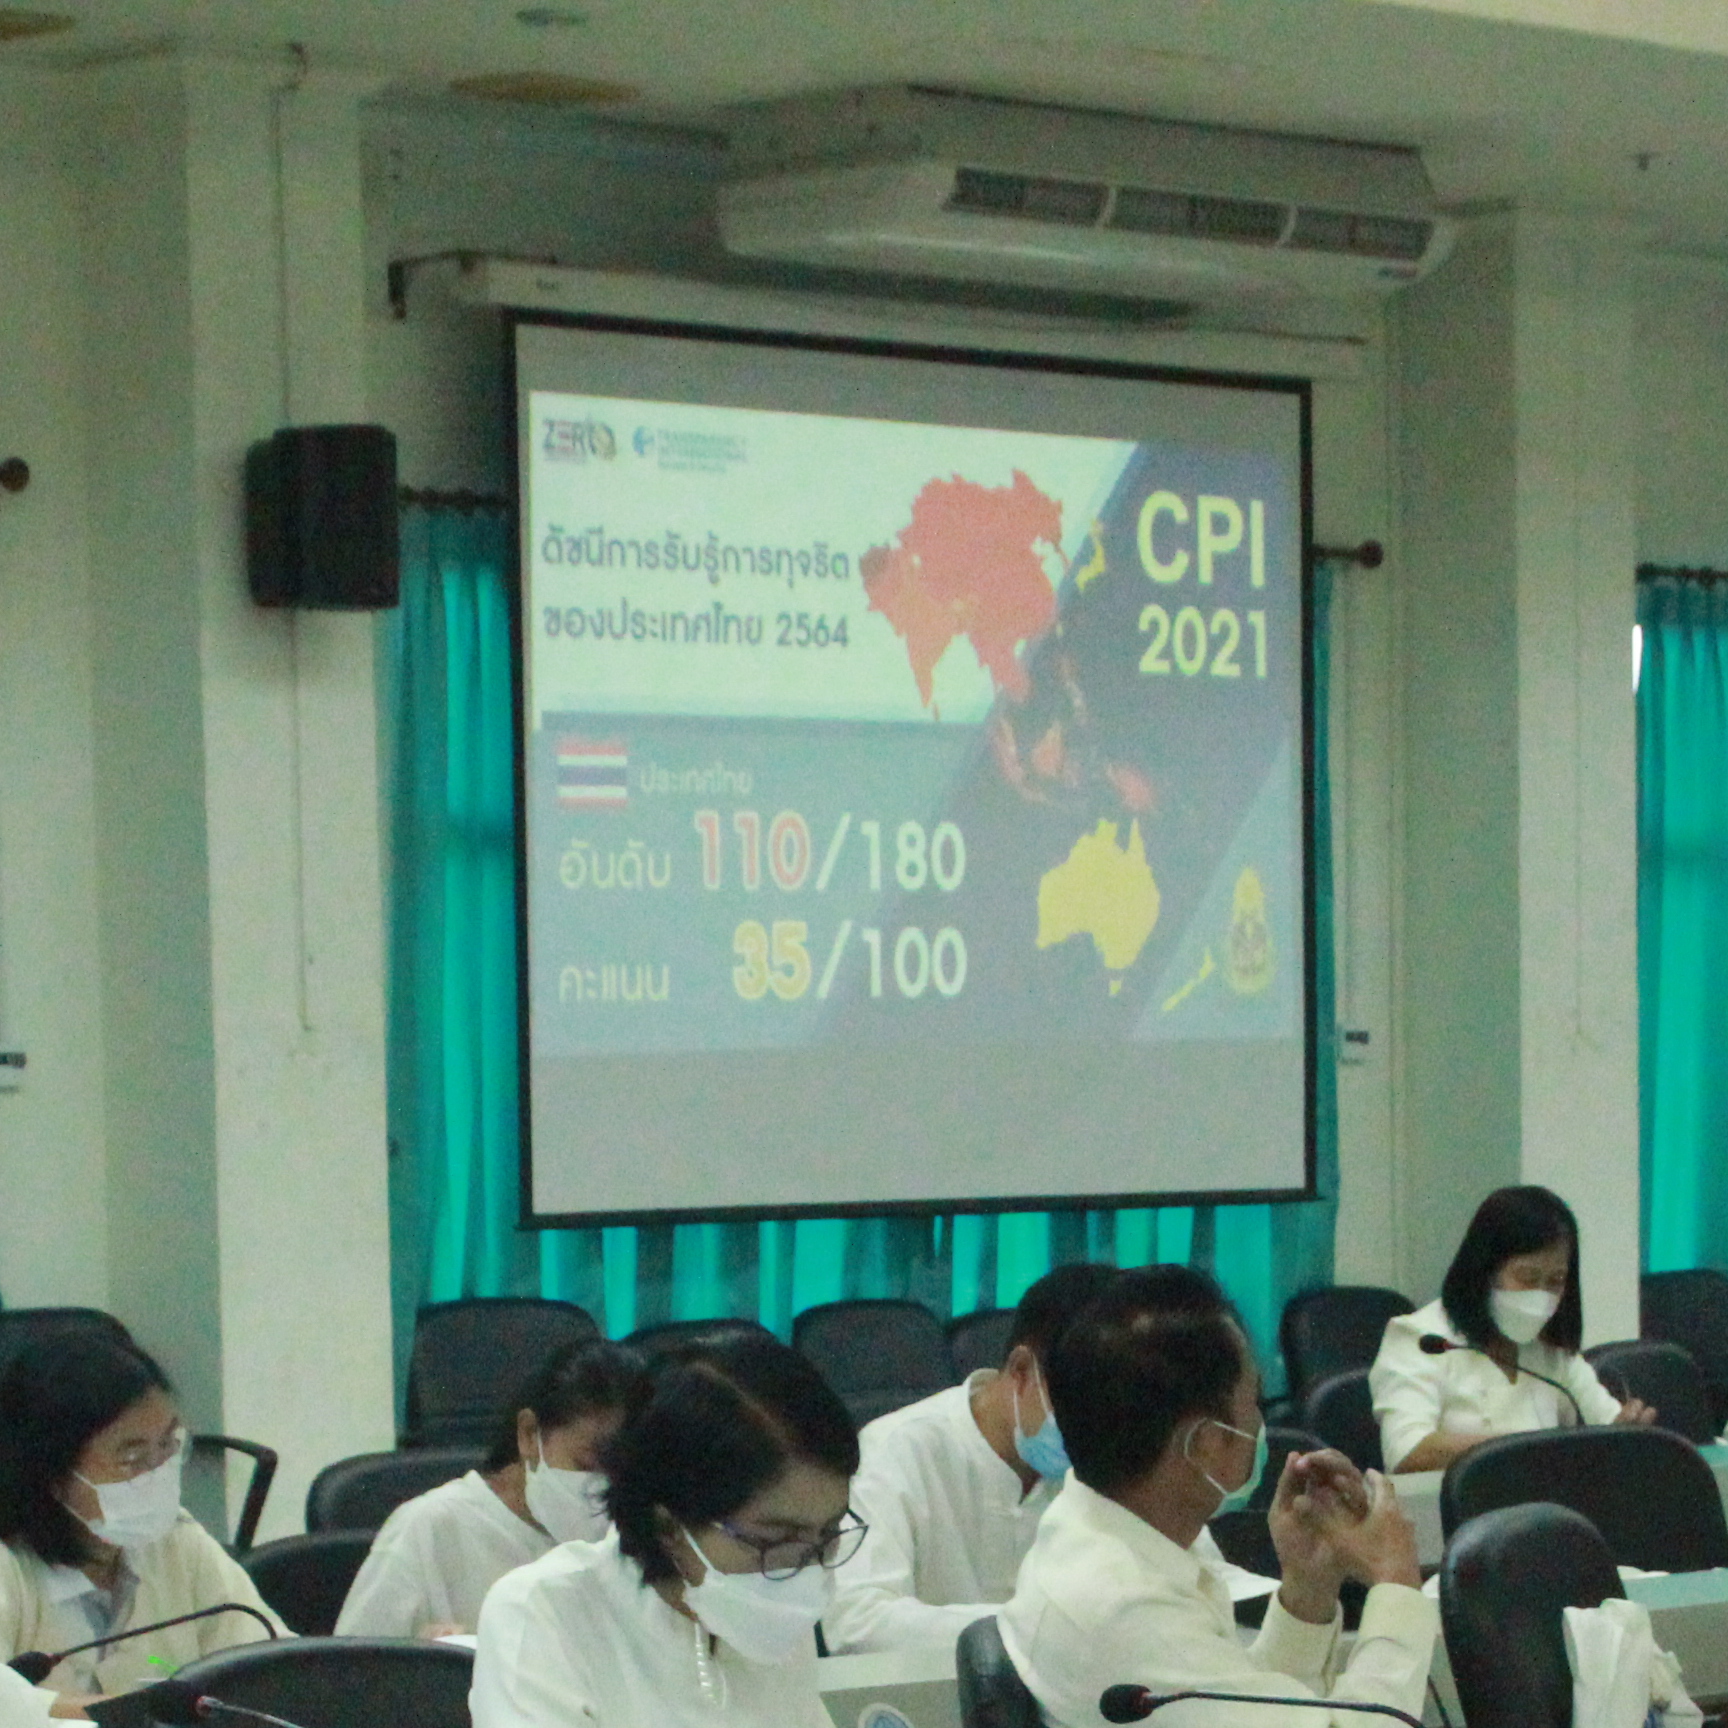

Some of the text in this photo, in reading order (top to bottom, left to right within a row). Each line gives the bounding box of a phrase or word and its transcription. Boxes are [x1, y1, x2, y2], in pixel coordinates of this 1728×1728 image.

[541, 523, 850, 588] ดัชนีการรับรู้การทุจริต
[1137, 491, 1265, 588] CPI
[542, 597, 848, 648] ของประเทศไทย 2564
[1138, 604, 1267, 679] 2021
[640, 762, 753, 795] ประเทศไทย
[558, 810, 966, 891] อันดับ 110/180
[558, 919, 967, 1001] คะแนน 35/100
